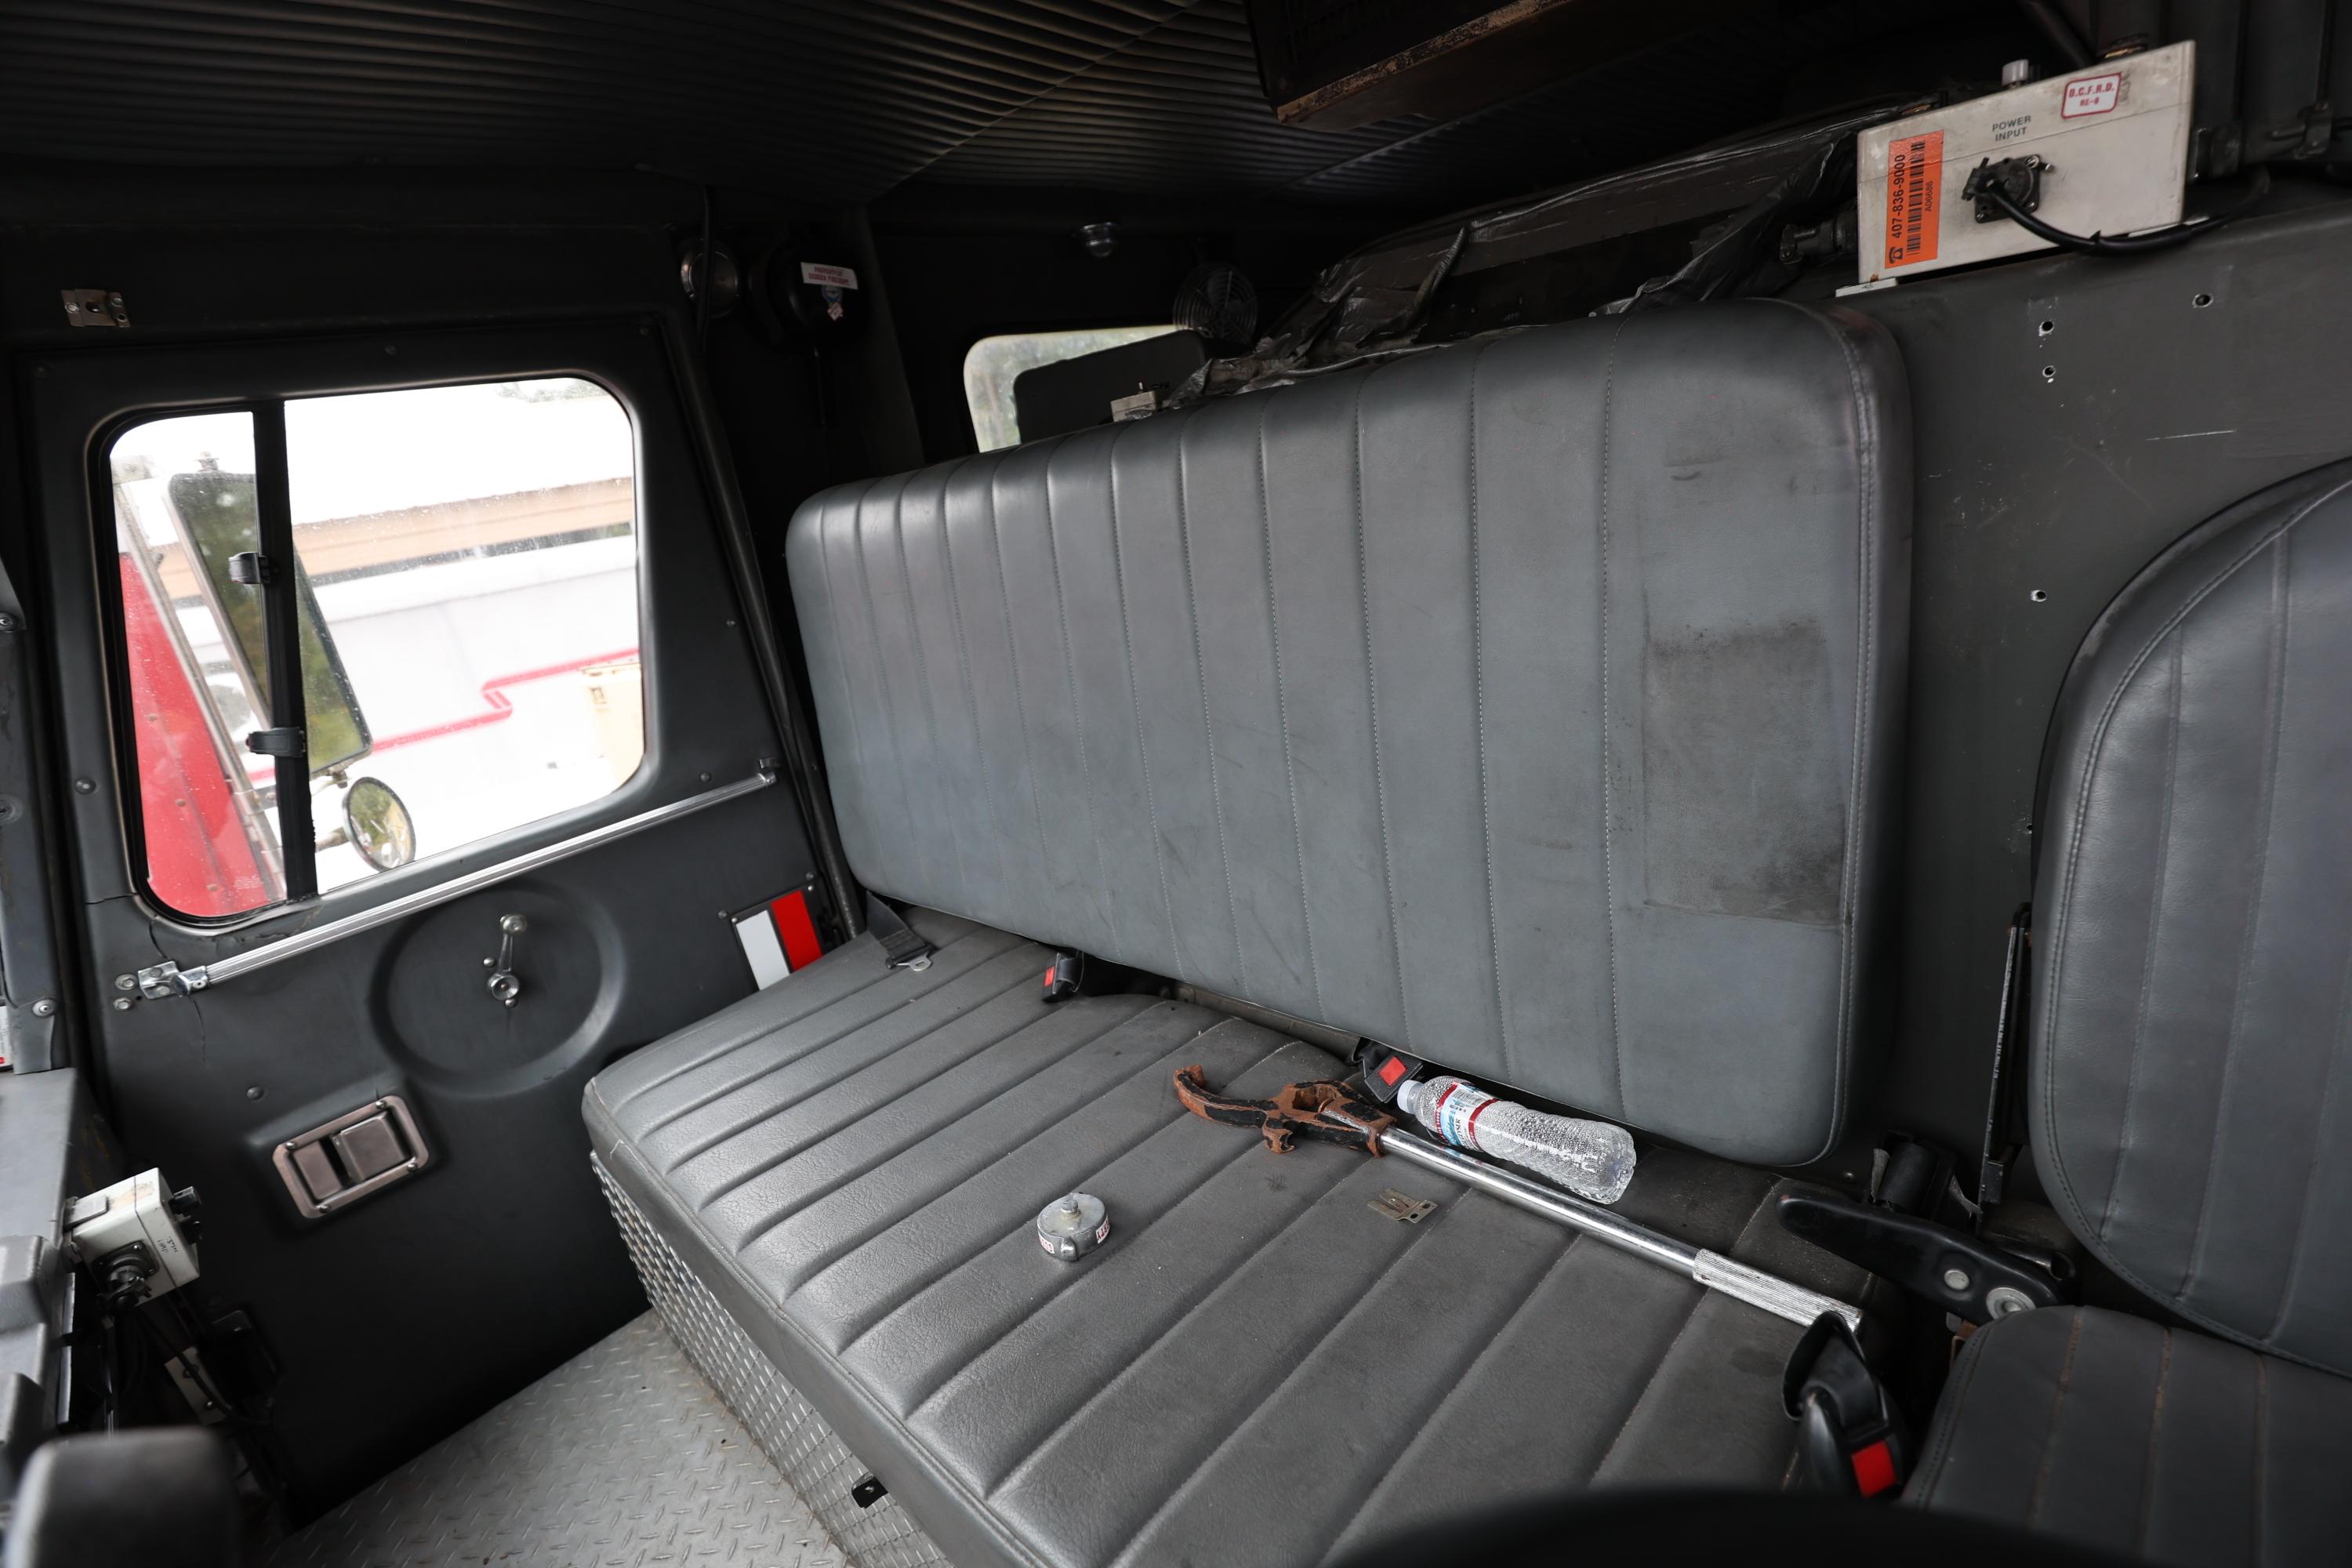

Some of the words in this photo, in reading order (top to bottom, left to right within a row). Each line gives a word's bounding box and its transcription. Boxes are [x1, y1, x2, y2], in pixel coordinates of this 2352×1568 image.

[1992, 115, 2031, 132] POWER
[1995, 126, 2027, 142] INPUT
[1892, 154, 1905, 238] 407-836-9000
